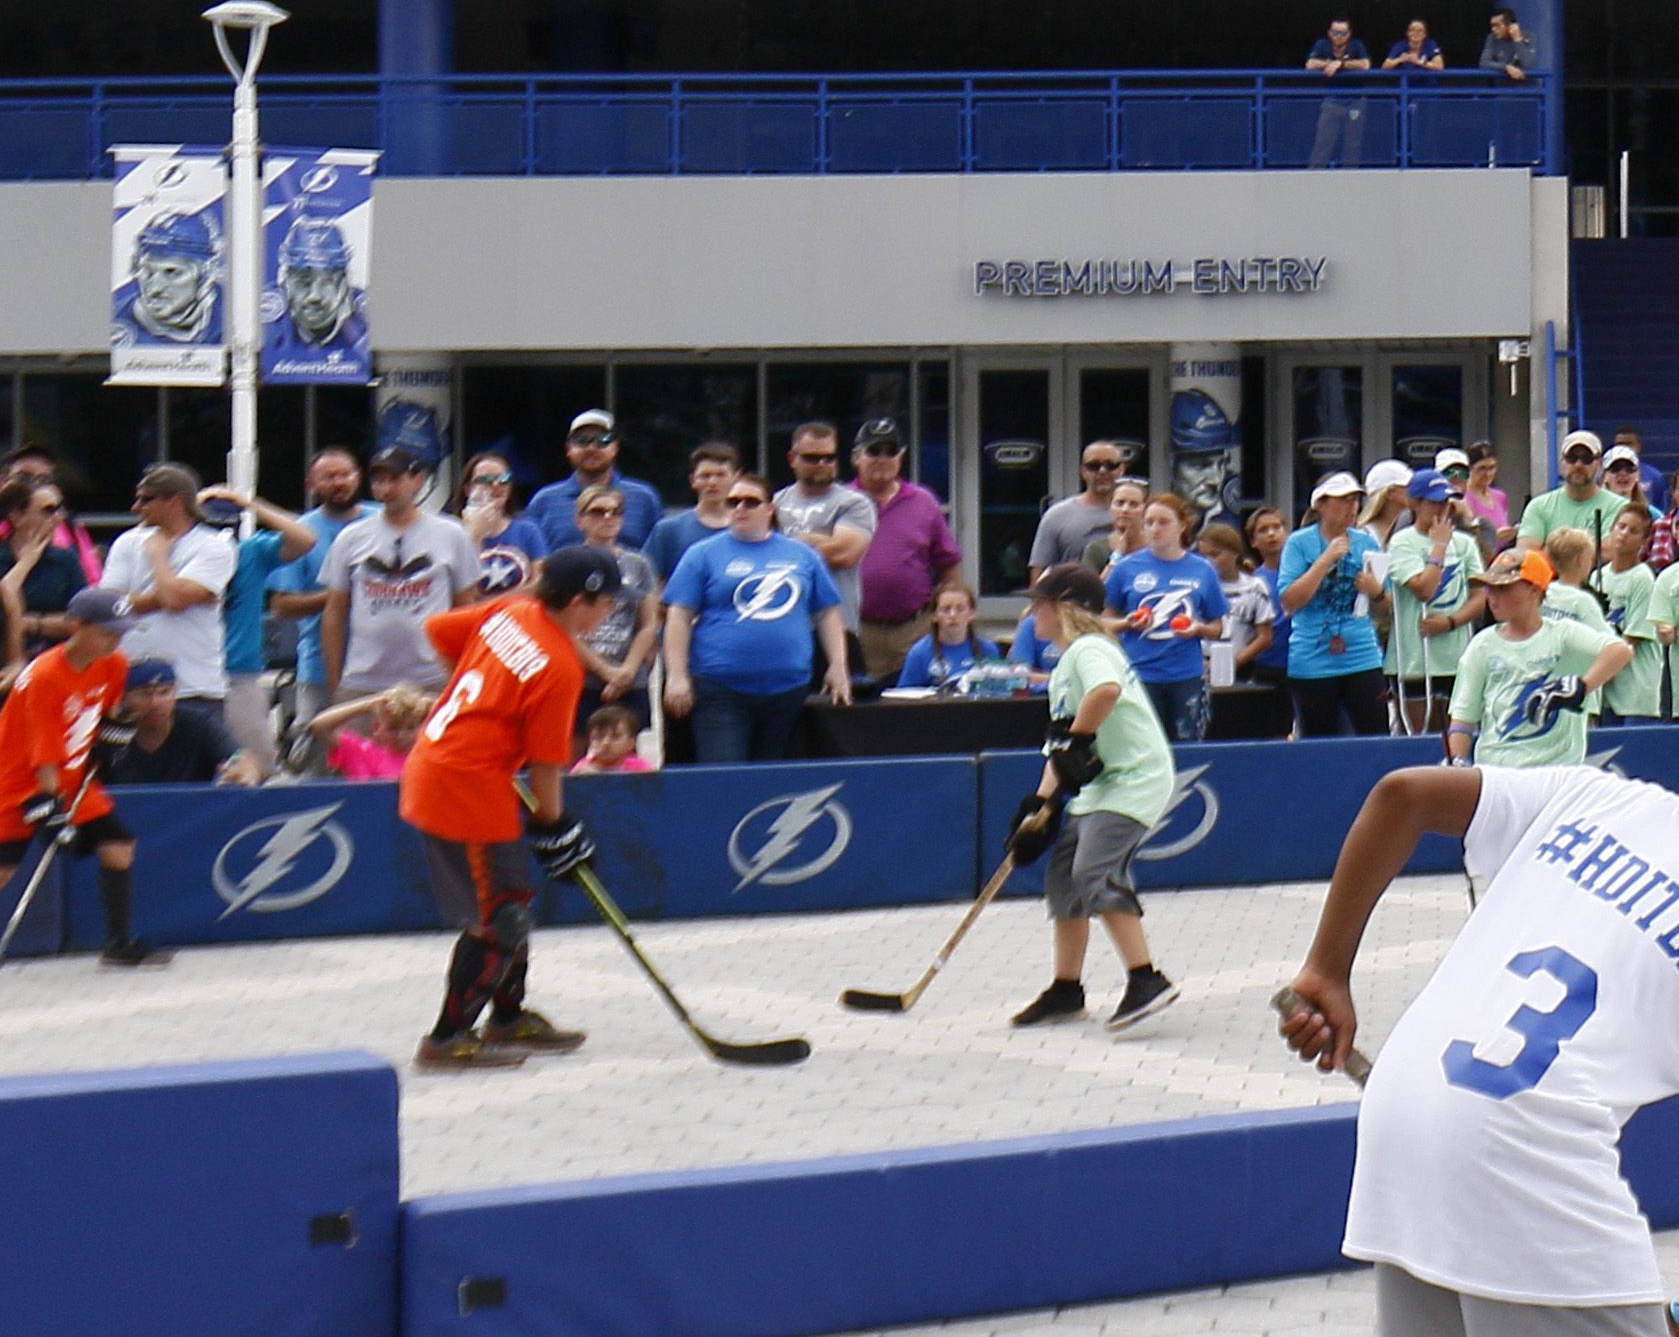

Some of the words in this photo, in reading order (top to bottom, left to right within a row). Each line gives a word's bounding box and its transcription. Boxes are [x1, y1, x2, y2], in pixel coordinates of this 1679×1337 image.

[973, 258, 1175, 296] PREMIUM
[1192, 256, 1327, 295] ENTRY
[1439, 944, 1599, 1102] 3
